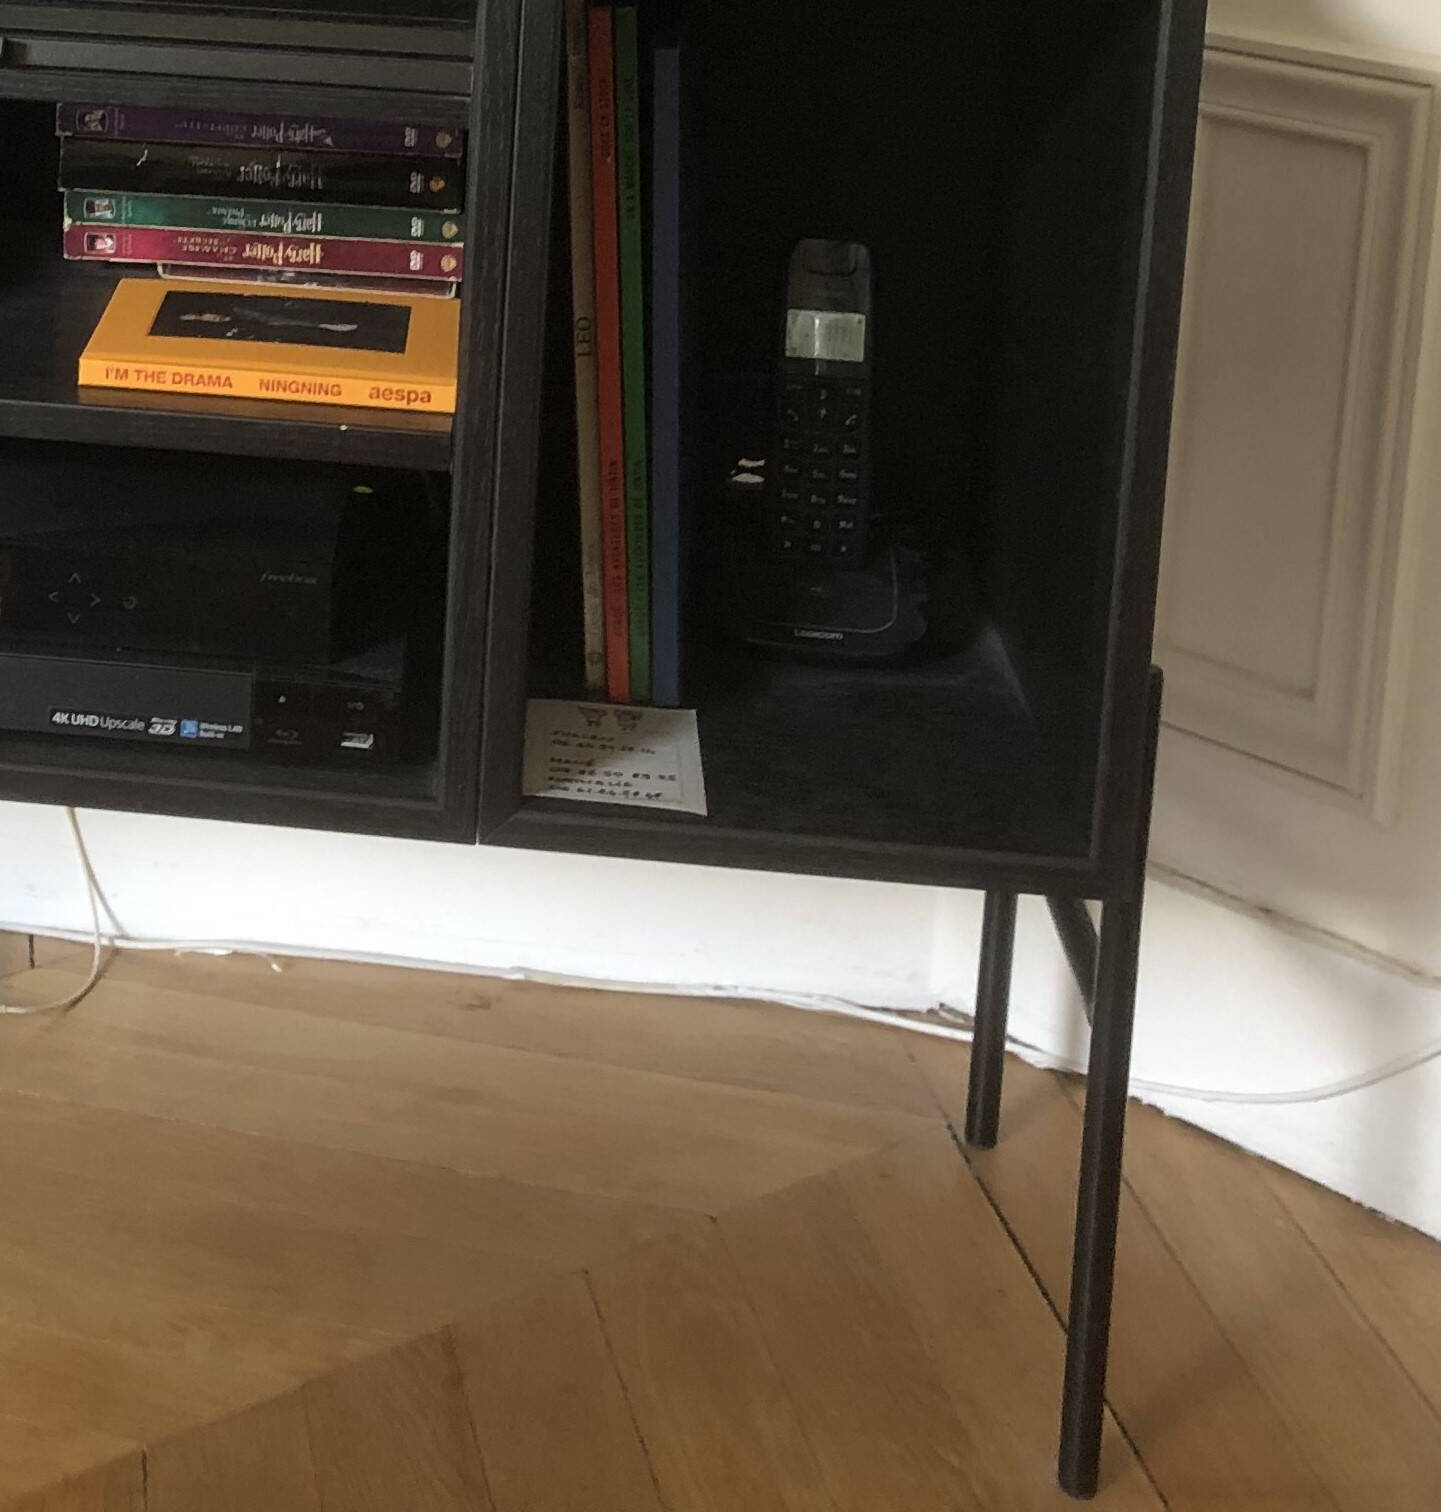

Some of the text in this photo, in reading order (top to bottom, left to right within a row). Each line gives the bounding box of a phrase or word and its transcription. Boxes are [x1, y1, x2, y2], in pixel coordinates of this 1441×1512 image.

[258, 209, 292, 234] Potter
[292, 211, 323, 233] Harry
[241, 240, 324, 266] Harry Potter
[576, 316, 593, 359] LEO
[104, 366, 234, 391] I'M THE DRAMA
[258, 378, 343, 398] NINGNING
[368, 385, 432, 406] aespa
[51, 710, 147, 732] 4K UHD Upscale
